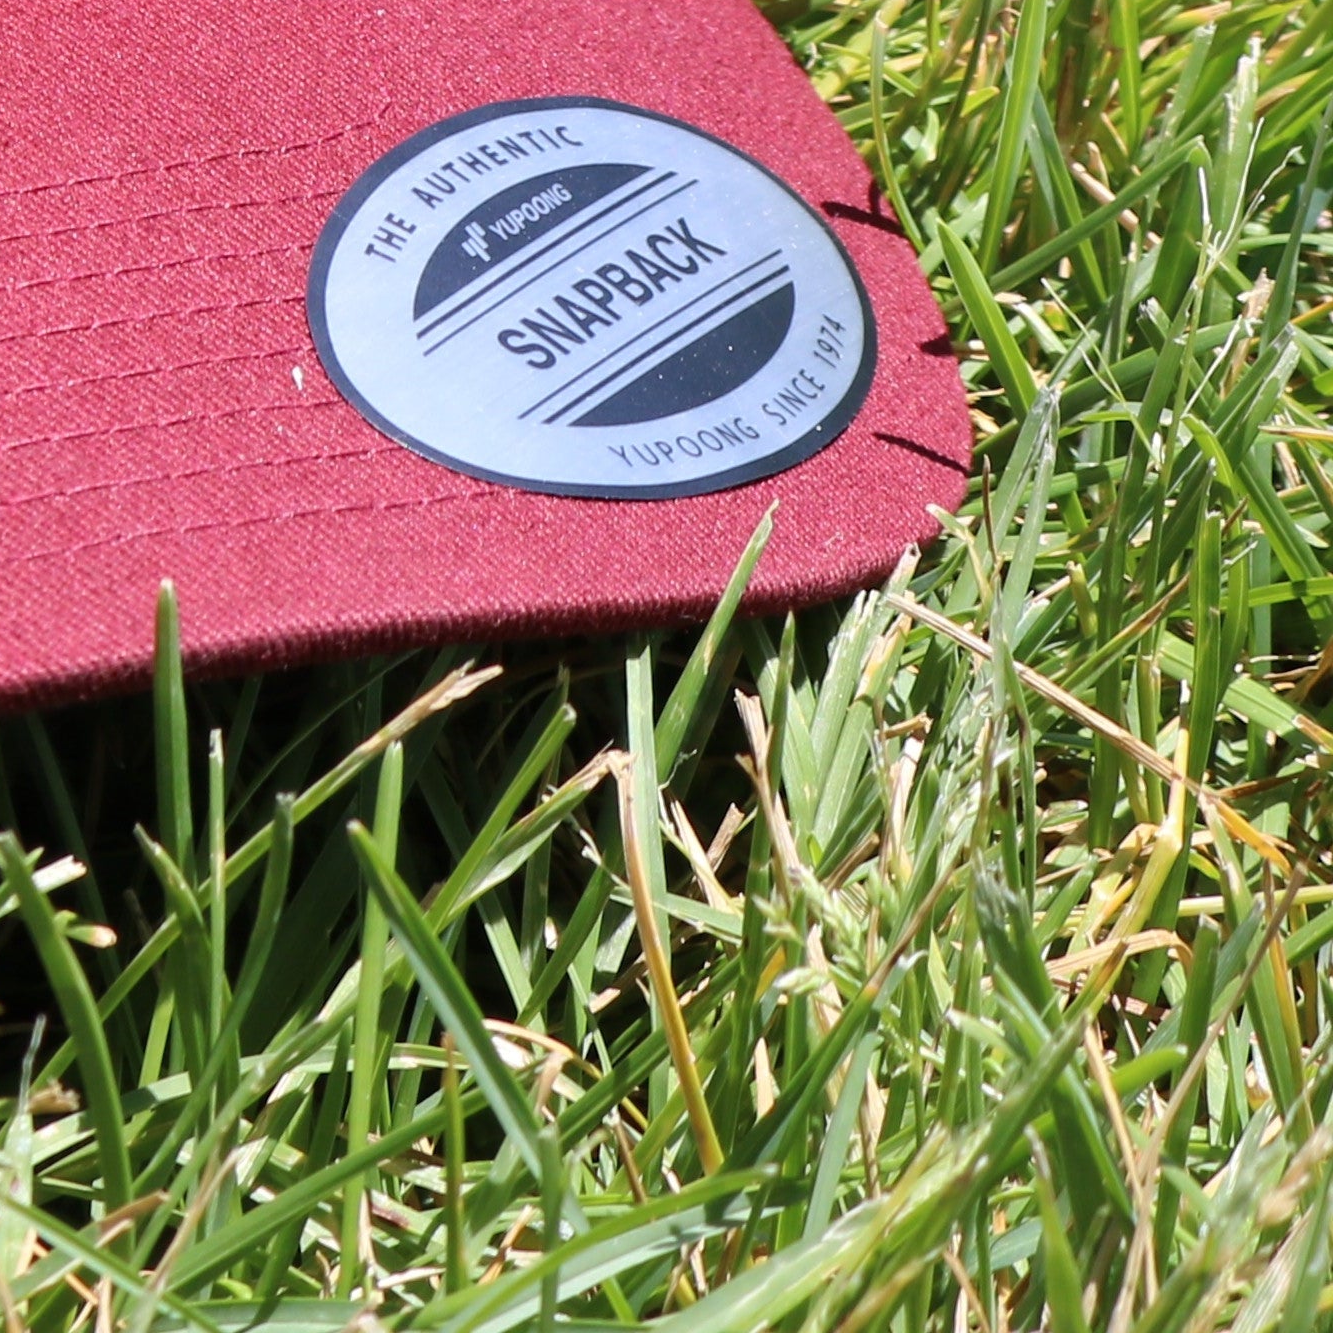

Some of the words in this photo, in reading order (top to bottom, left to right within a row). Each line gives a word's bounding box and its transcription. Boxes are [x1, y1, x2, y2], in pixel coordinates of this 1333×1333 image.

[365, 211, 417, 264] THE
[411, 124, 584, 209] AUTHENTIC
[488, 182, 573, 243] YUPOONG
[496, 216, 727, 370] SNAPBACK
[608, 417, 761, 469] YUPOONG
[761, 369, 825, 427] SINCE
[811, 315, 848, 370] 1974
